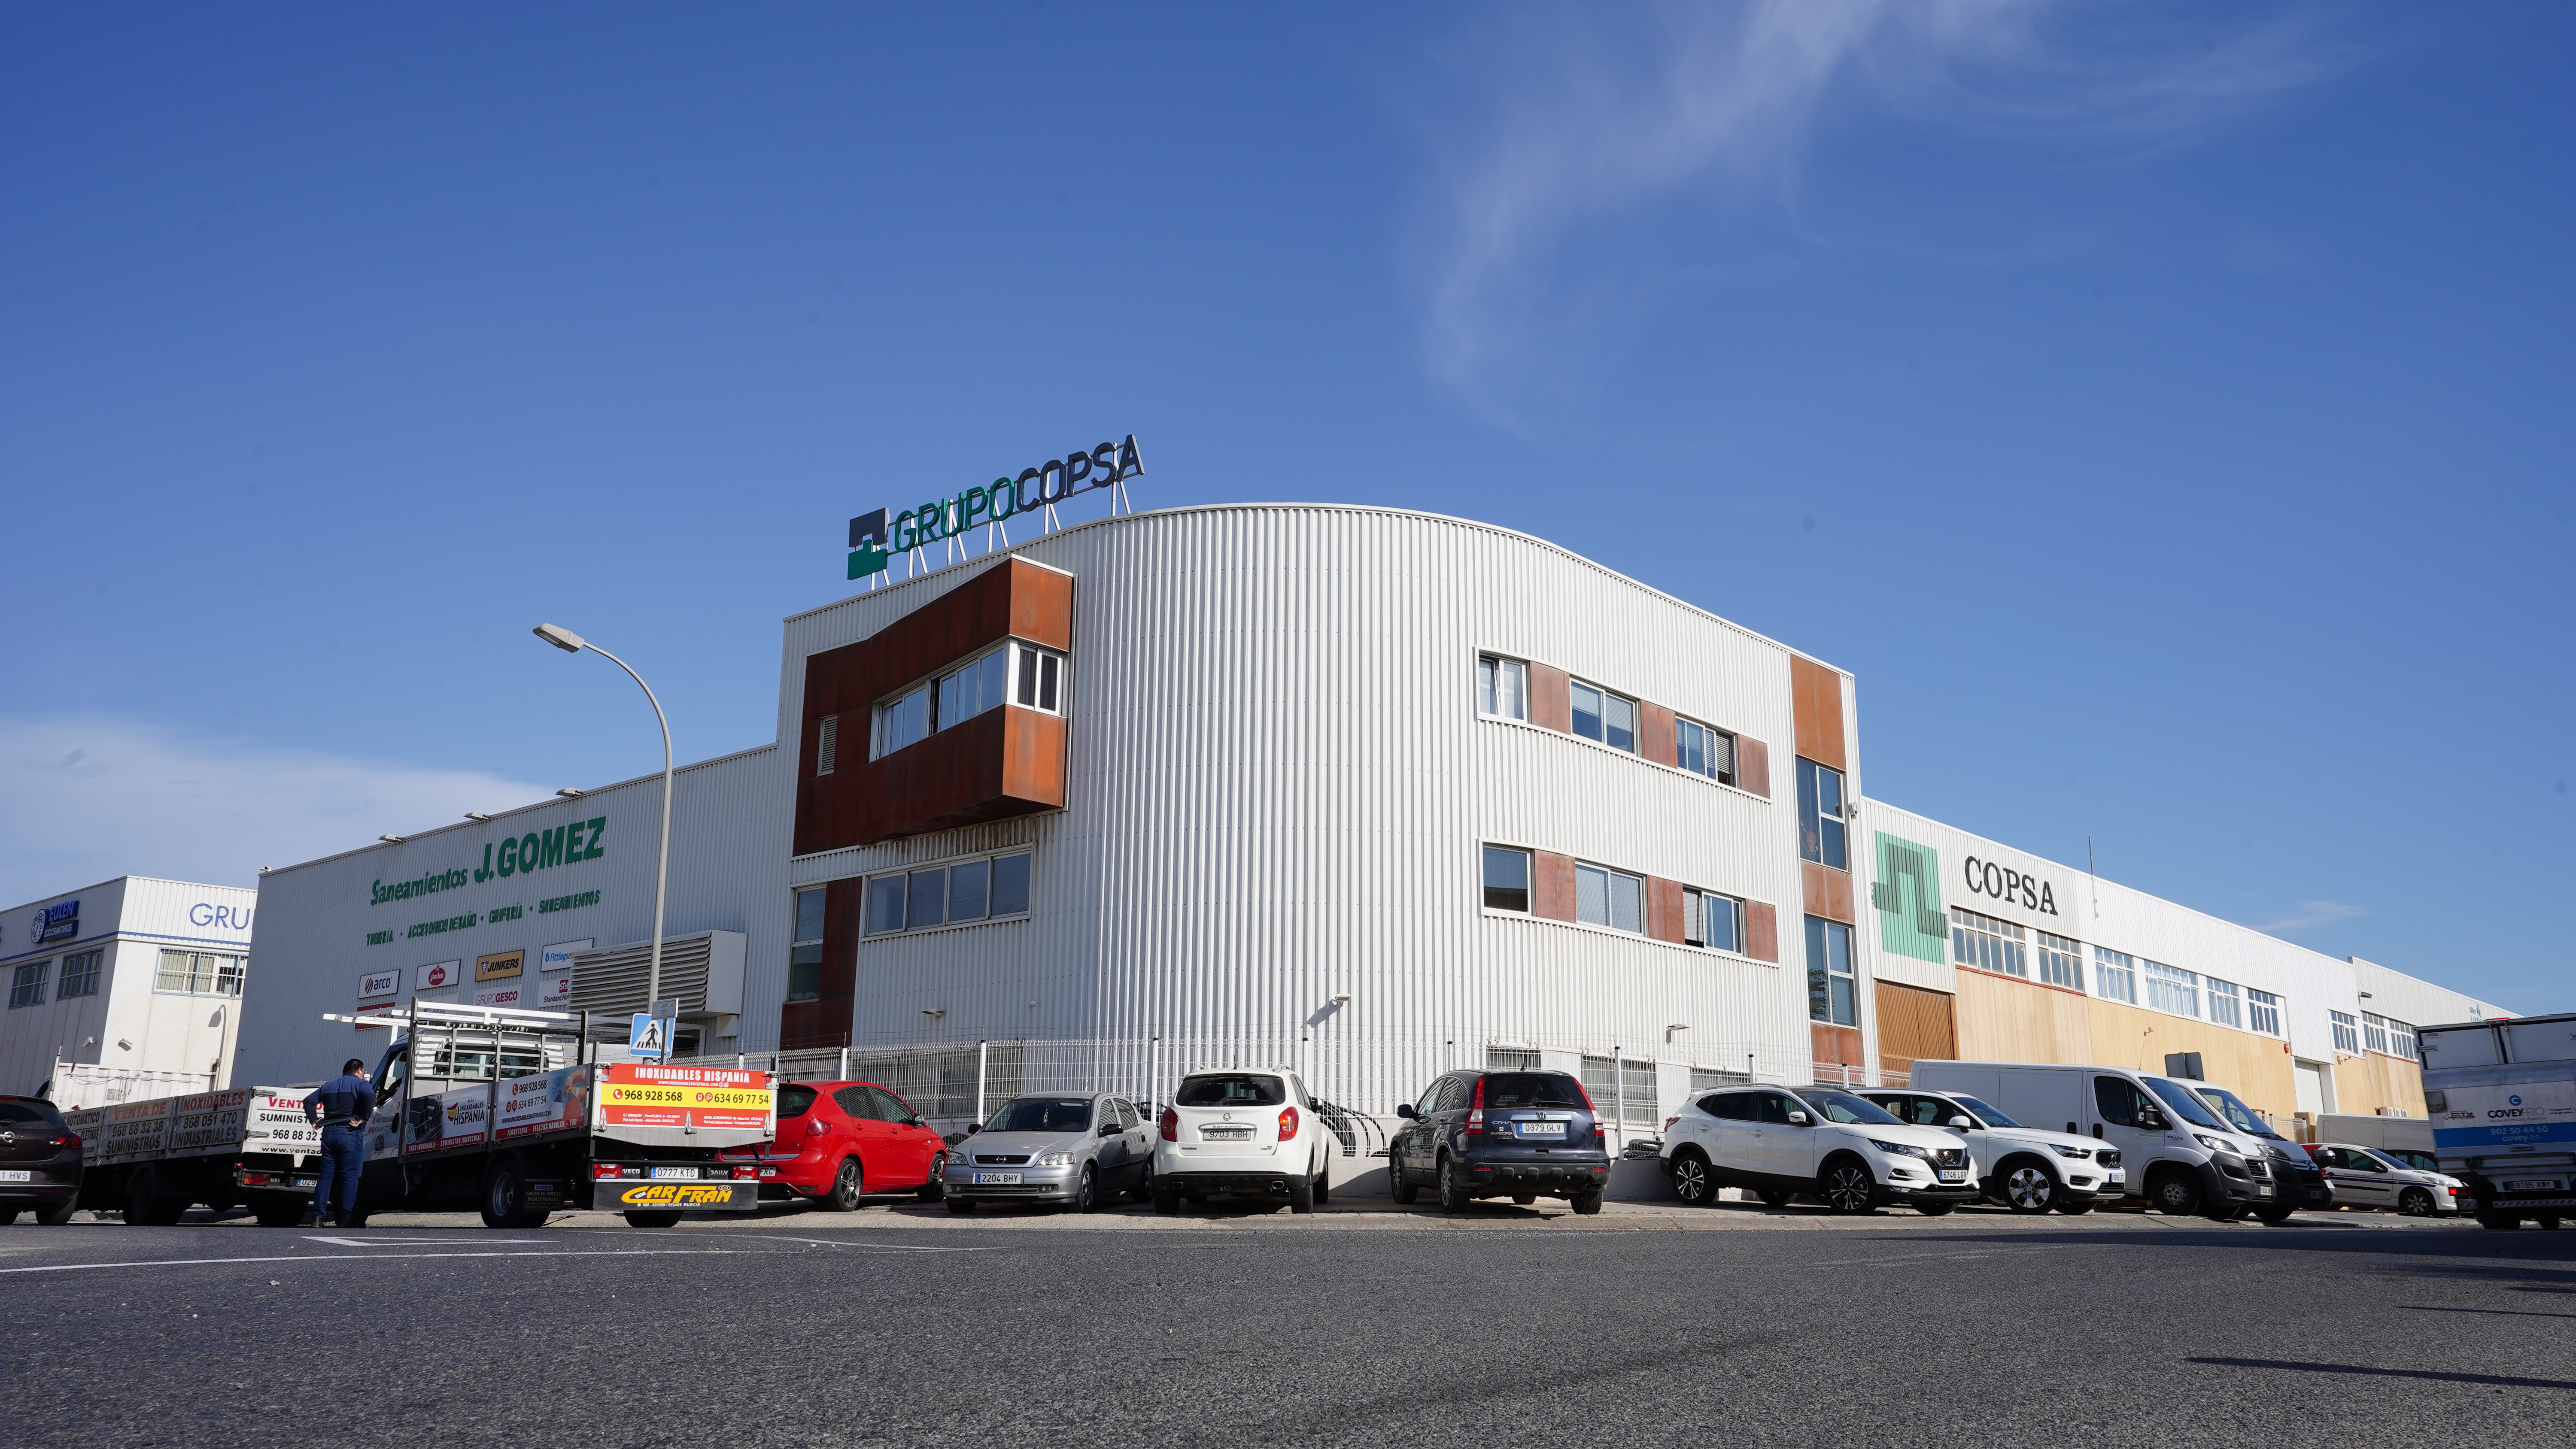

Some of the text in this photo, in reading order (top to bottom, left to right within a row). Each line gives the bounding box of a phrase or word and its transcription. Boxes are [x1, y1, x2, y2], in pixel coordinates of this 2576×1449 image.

[371, 816, 607, 906] Saneamientos J.GOMEZ
[1965, 856, 2058, 916] COPSA
[49, 900, 76, 922] EULEN
[190, 903, 255, 930] GRU
[407, 918, 448, 938] ACCESORIOS
[449, 917, 458, 931] DE
[489, 902, 522, 923] GRIFERÍA
[539, 889, 600, 914] SANEAMIENTOS
[487, 958, 519, 973] JUNKERS
[374, 977, 390, 990] arco
[544, 994, 562, 1003] Standard
[635, 1067, 750, 1083] INOXIDABLES HISPANIA
[519, 1079, 547, 1094] 968 928 568
[179, 1091, 245, 1112] INOXIDABLES
[268, 1097, 305, 1109] VENT
[518, 1095, 547, 1109] 634 69 77 54
[625, 1090, 682, 1101] 968 928 568
[714, 1094, 769, 1104] 634 69 77 54
[114, 1102, 167, 1121] VENTA DE
[460, 1102, 484, 1112] INOXIDABLES
[183, 1112, 237, 1129] 868 051 470
[259, 1113, 310, 1124] SUMINIST
[453, 1106, 485, 1126] HISPANIA
[112, 1121, 164, 1137] 968 88 32 38
[174, 1126, 237, 1147] INDUSTRIALES
[273, 1129, 290, 1140] 968
[292, 1131, 303, 1140] 88
[306, 1131, 317, 1141] 32
[507, 1127, 528, 1137] FERRETERIA
[532, 1123, 548, 1132] EFECTOS
[549, 1120, 565, 1129] NAVALES
[106, 1134, 161, 1155] SUMINISTROS
[417, 1141, 436, 1150] INOXIDABLE
[440, 1137, 461, 1147] SUMINISTRO
[461, 1134, 482, 1143] INDUSTRIAL
[657, 1168, 695, 1177] 0777 KTD
